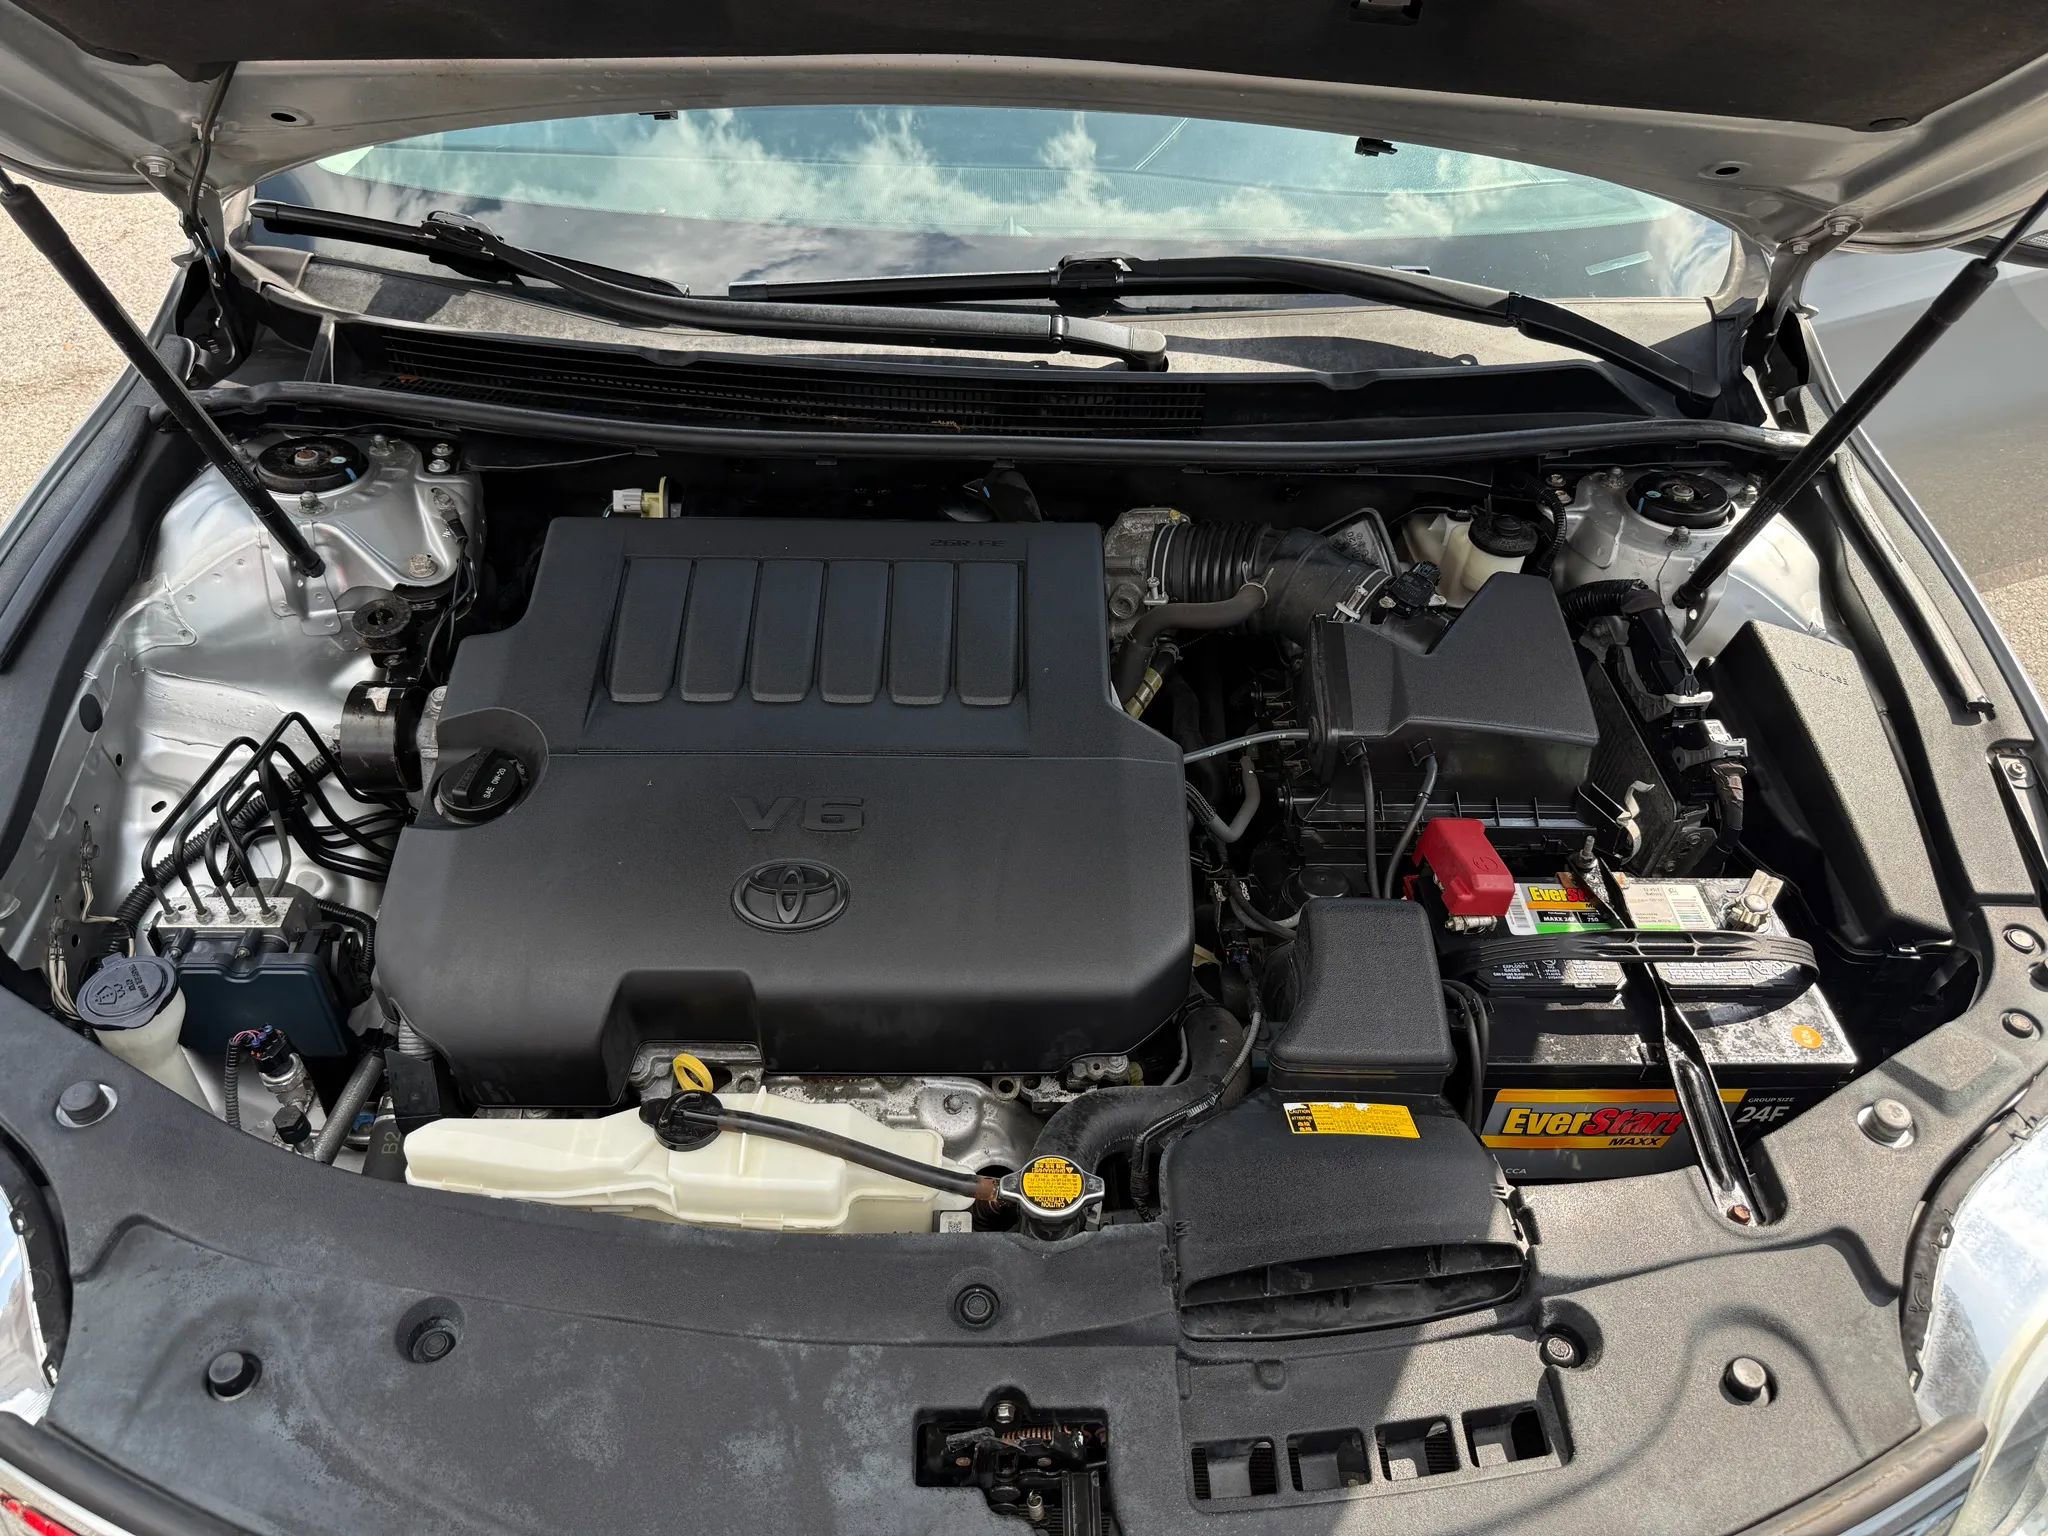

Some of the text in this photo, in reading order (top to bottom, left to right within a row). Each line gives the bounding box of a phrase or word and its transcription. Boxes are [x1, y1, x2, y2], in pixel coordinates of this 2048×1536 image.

[482, 767, 506, 799] SAE 0W-20
[729, 796, 864, 832] V6
[1501, 1107, 1685, 1136] EverStart
[1736, 1105, 1790, 1123] 24F
[381, 1131, 402, 1155] B2
[1608, 1137, 1661, 1146] MAXX
[1505, 1167, 1527, 1175] CCA
